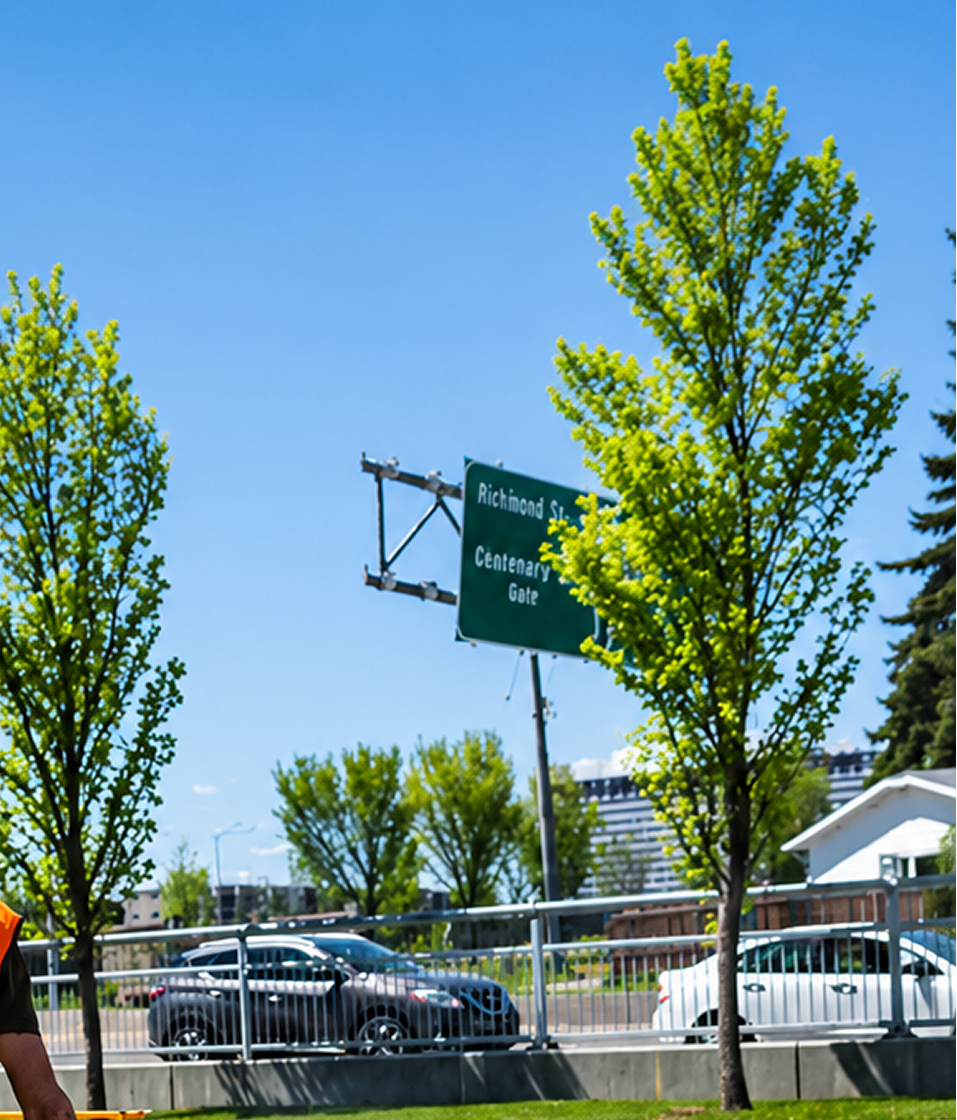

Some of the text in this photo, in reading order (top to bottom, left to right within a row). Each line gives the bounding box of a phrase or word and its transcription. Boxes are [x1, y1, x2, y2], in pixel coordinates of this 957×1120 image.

[477, 481, 544, 520] Richmond
[474, 544, 551, 583] Centenary
[508, 582, 539, 606] Gate
